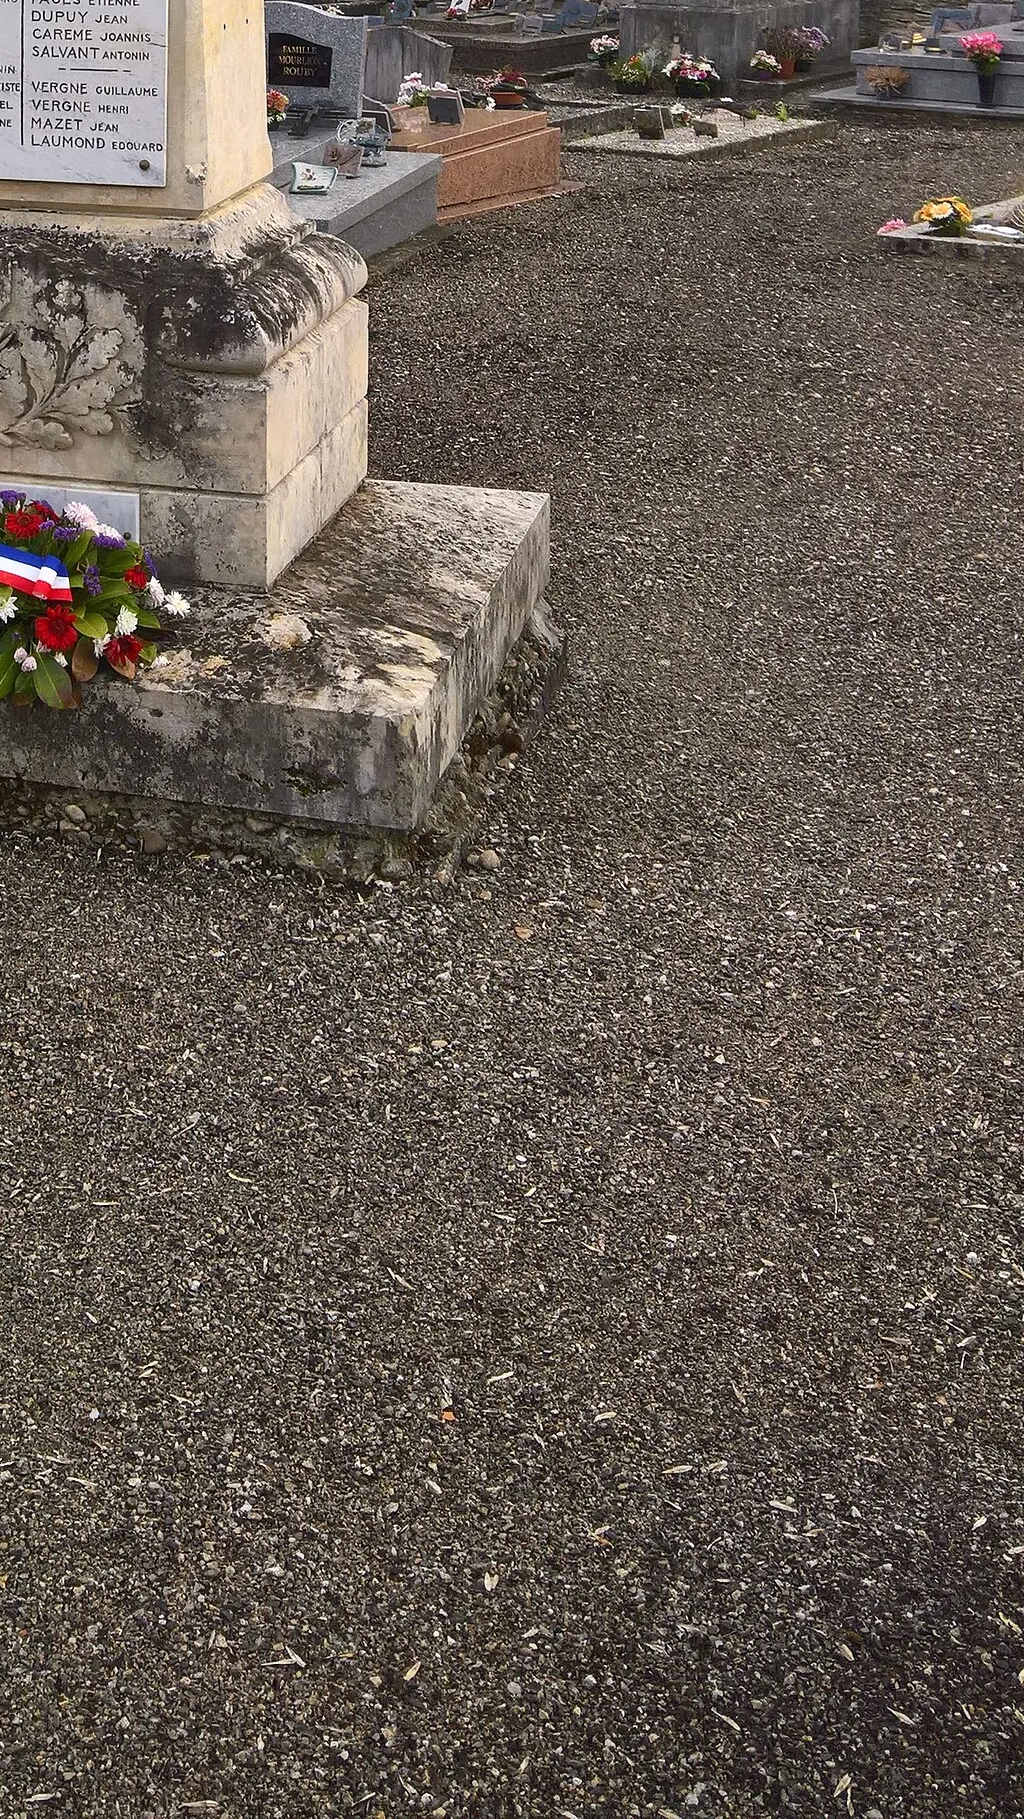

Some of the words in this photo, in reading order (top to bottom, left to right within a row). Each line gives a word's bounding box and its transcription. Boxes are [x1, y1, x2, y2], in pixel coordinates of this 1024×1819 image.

[31, 10, 89, 23] DUPUY
[95, 14, 128, 24] JEAN
[32, 28, 93, 41] CAREME
[100, 32, 151, 42] JOANNIS
[32, 45, 100, 59] SALVANT
[102, 51, 150, 60] ANTONIN
[282, 45, 317, 54] FAMILLE
[283, 67, 316, 76] ROUBY
[31, 81, 88, 95] VERGNE
[95, 86, 158, 97] GUILLAUME
[31, 99, 91, 113] VERGNE
[98, 104, 129, 114] HENRI
[31, 117, 83, 130] MAZET
[90, 122, 119, 132] JEAN
[31, 134, 106, 149] LAUMOND
[112, 141, 163, 152] EDOUARD
